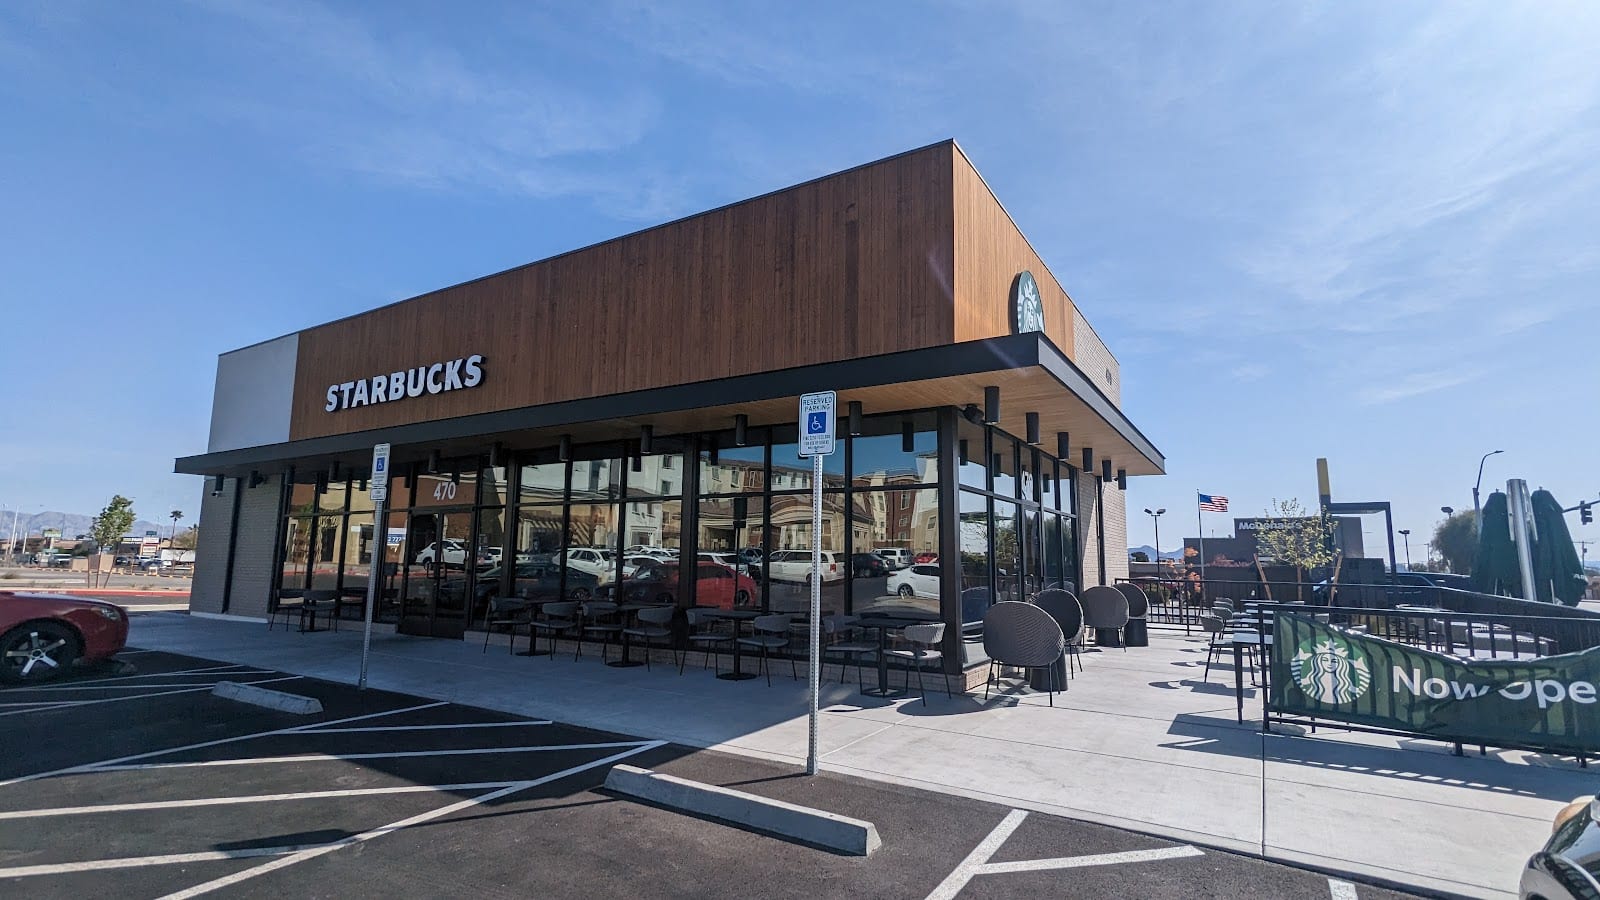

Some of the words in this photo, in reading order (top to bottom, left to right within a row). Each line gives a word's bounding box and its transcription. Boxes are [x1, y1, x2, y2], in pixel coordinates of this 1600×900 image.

[325, 354, 485, 412] STARBUCKS
[803, 397, 833, 406] RESERVED
[805, 403, 831, 412] PARKING
[433, 481, 456, 500] 470
[1238, 521, 1303, 530] McDonad's
[1392, 665, 1491, 700] Now
